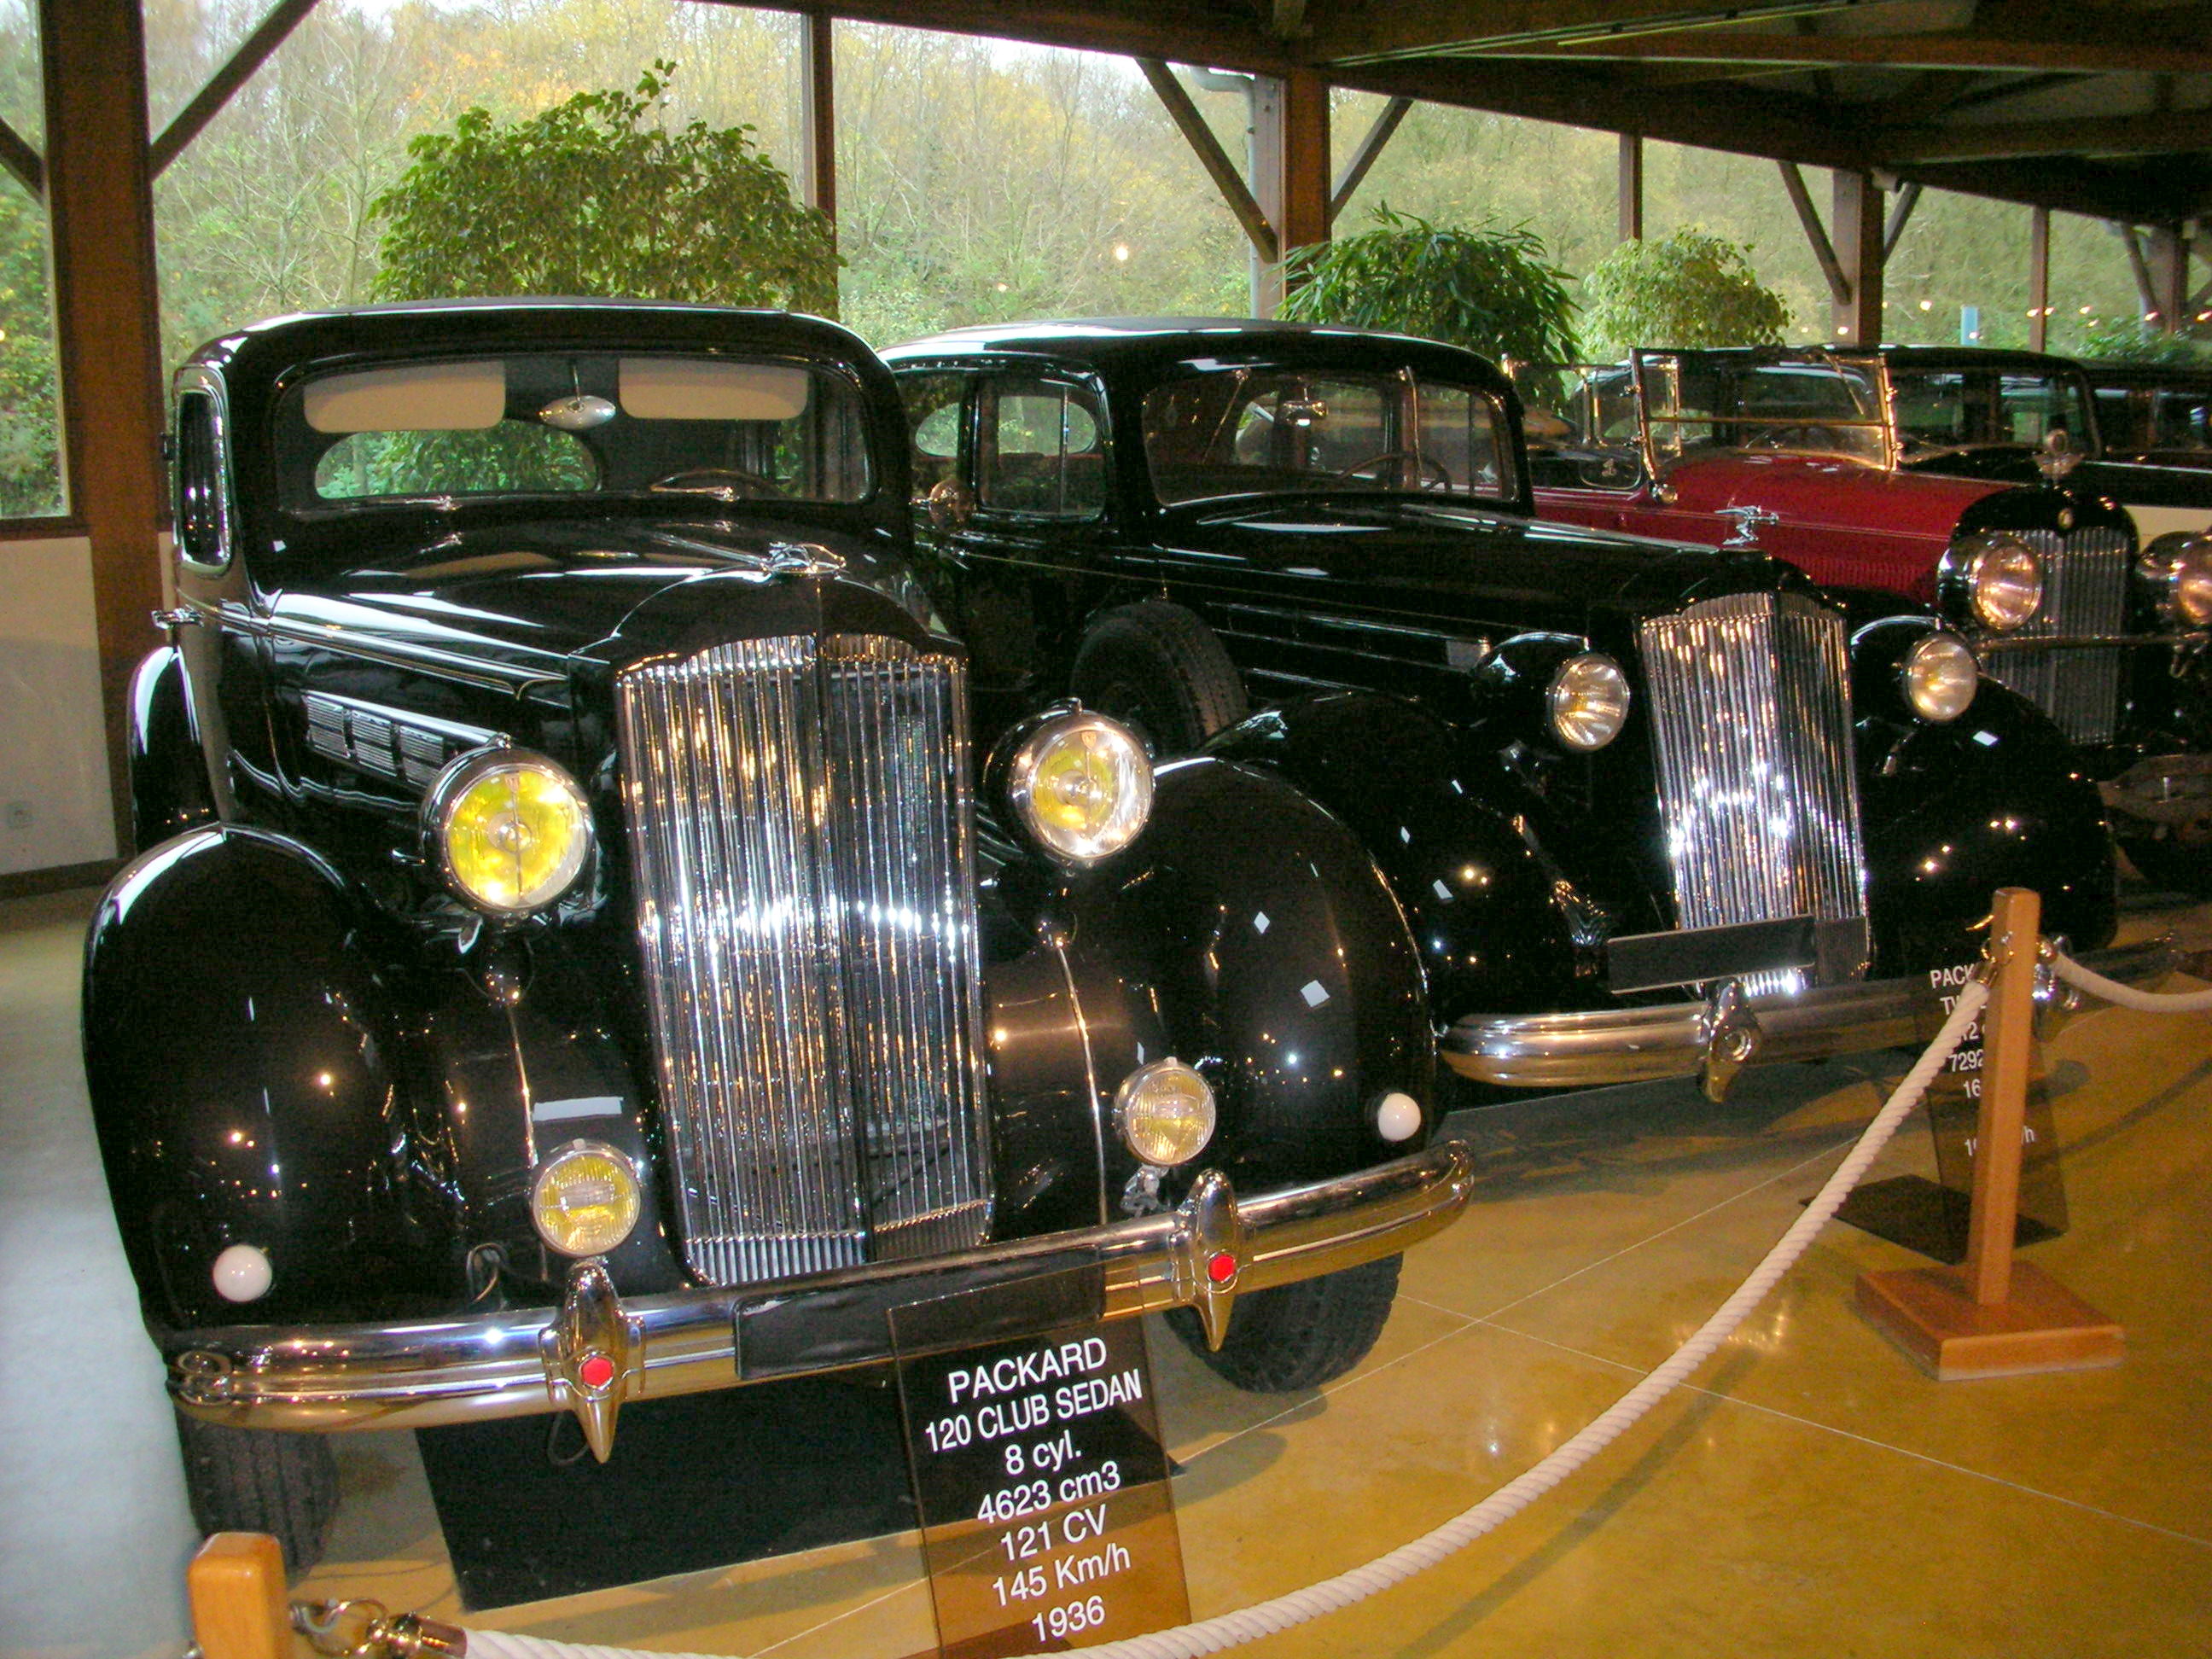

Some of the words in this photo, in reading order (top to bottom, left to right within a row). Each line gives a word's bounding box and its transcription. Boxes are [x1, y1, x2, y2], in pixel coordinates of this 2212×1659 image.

[1930, 963, 1975, 989] PACK
[948, 1337, 1107, 1403] PACKARD
[925, 1414, 971, 1452] 120
[978, 1394, 1049, 1439] CLUB
[1057, 1369, 1142, 1420] SEDAN
[1005, 1444, 1023, 1476] 8
[1033, 1430, 1081, 1472] cyl.
[977, 1480, 1051, 1524] 4623
[1059, 1461, 1121, 1503] cm3
[1001, 1522, 1051, 1561] 121
[1063, 1504, 1106, 1544] CV
[992, 1566, 1047, 1607] 145
[1055, 1542, 1131, 1589] Km/h
[1032, 1595, 1105, 1643] 1936
